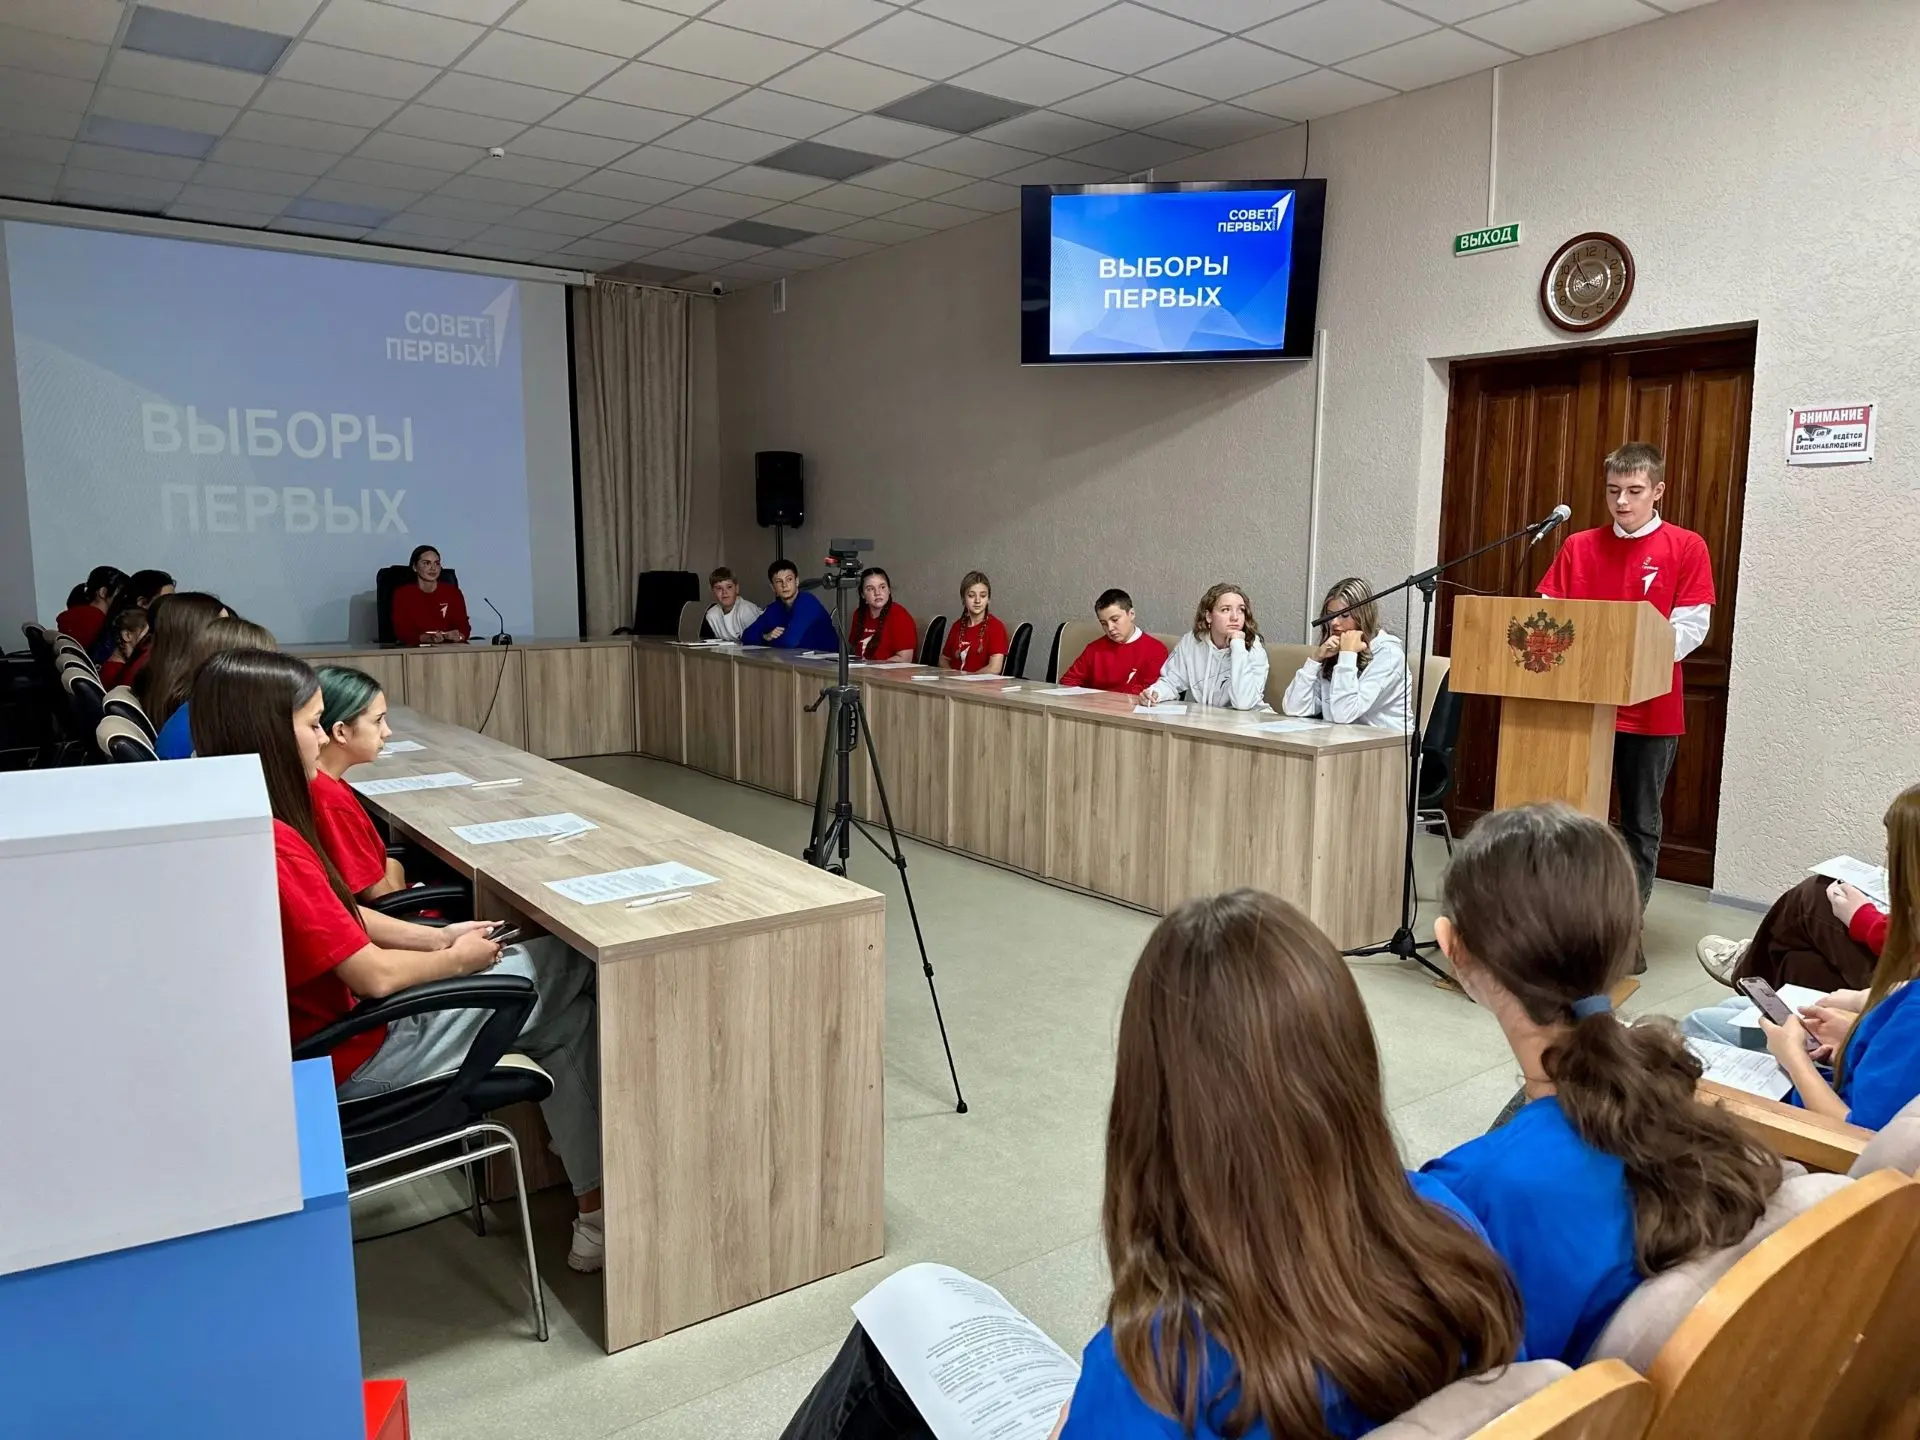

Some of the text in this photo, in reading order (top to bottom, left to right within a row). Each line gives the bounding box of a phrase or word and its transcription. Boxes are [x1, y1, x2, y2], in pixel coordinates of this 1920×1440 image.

[1229, 209, 1273, 220] СОВЕТ
[1218, 221, 1272, 232] ПЕРВЫХ
[1460, 226, 1512, 249] ВЫХОД
[1586, 246, 1597, 257] 12
[1099, 255, 1228, 279] ВЫБОРЫ
[1561, 265, 1570, 274] 10
[1609, 258, 1619, 270] 2
[1613, 275, 1622, 285] 3
[1556, 281, 1563, 291] 9
[1104, 286, 1222, 309] ПЕРВЫХ
[1559, 296, 1567, 306] 8
[1607, 292, 1616, 303] 4
[1569, 305, 1576, 315] 7
[1581, 309, 1589, 319] 6
[1596, 303, 1604, 314] 5
[405, 310, 485, 338] СОВЕТ
[386, 337, 487, 367] ПЕРВЫХ
[1800, 408, 1864, 424] ВНИМАНИЕ
[142, 402, 414, 462] ВЫБОРЫ
[1795, 442, 1862, 450] ВИДЕОНАБЛЮДЕНИЕ
[160, 483, 410, 534] ПЕРВЫХ
